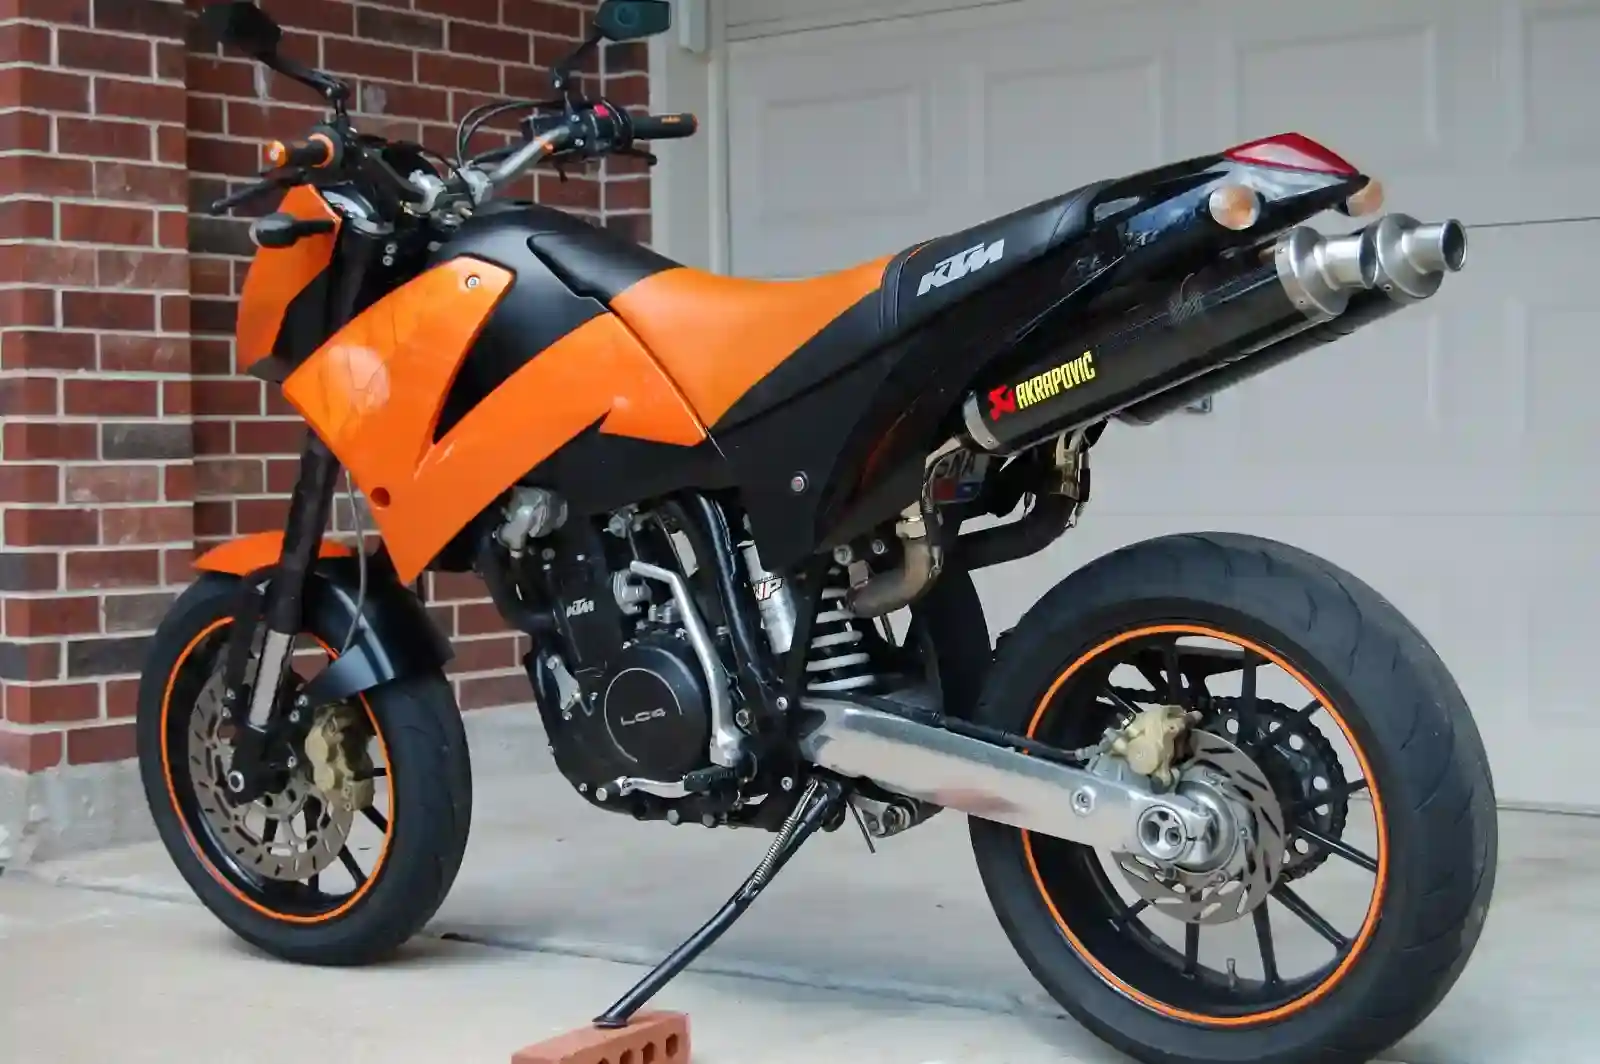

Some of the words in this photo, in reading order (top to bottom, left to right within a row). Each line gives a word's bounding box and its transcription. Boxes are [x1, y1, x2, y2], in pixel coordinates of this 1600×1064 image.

[917, 238, 1005, 297] KTM
[1016, 350, 1096, 410] AKRAPOVIČ
[566, 598, 595, 619] KTM
[620, 707, 666, 727] LC4
